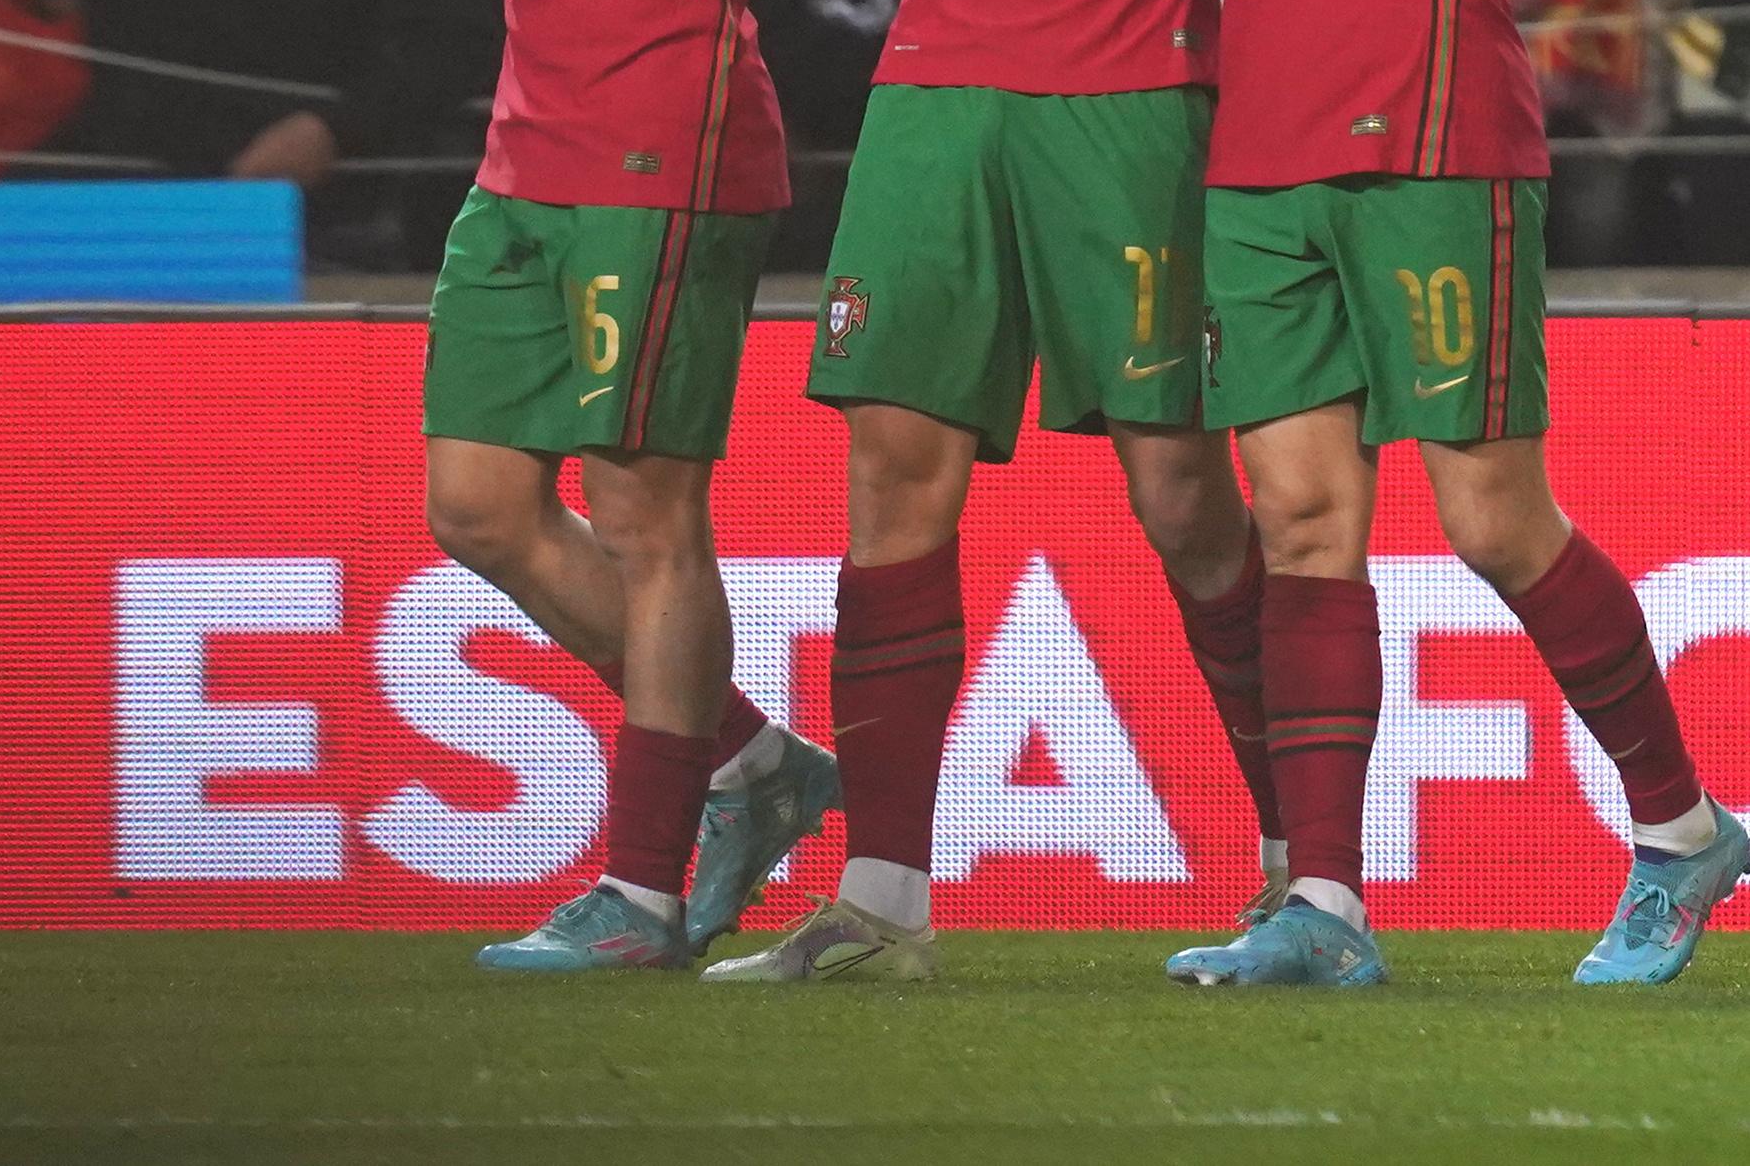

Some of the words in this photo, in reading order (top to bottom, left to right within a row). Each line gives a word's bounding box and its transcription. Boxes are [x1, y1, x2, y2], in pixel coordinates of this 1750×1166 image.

[585, 274, 620, 374] 6
[1124, 246, 1170, 343] 1
[1395, 265, 1474, 368] 10
